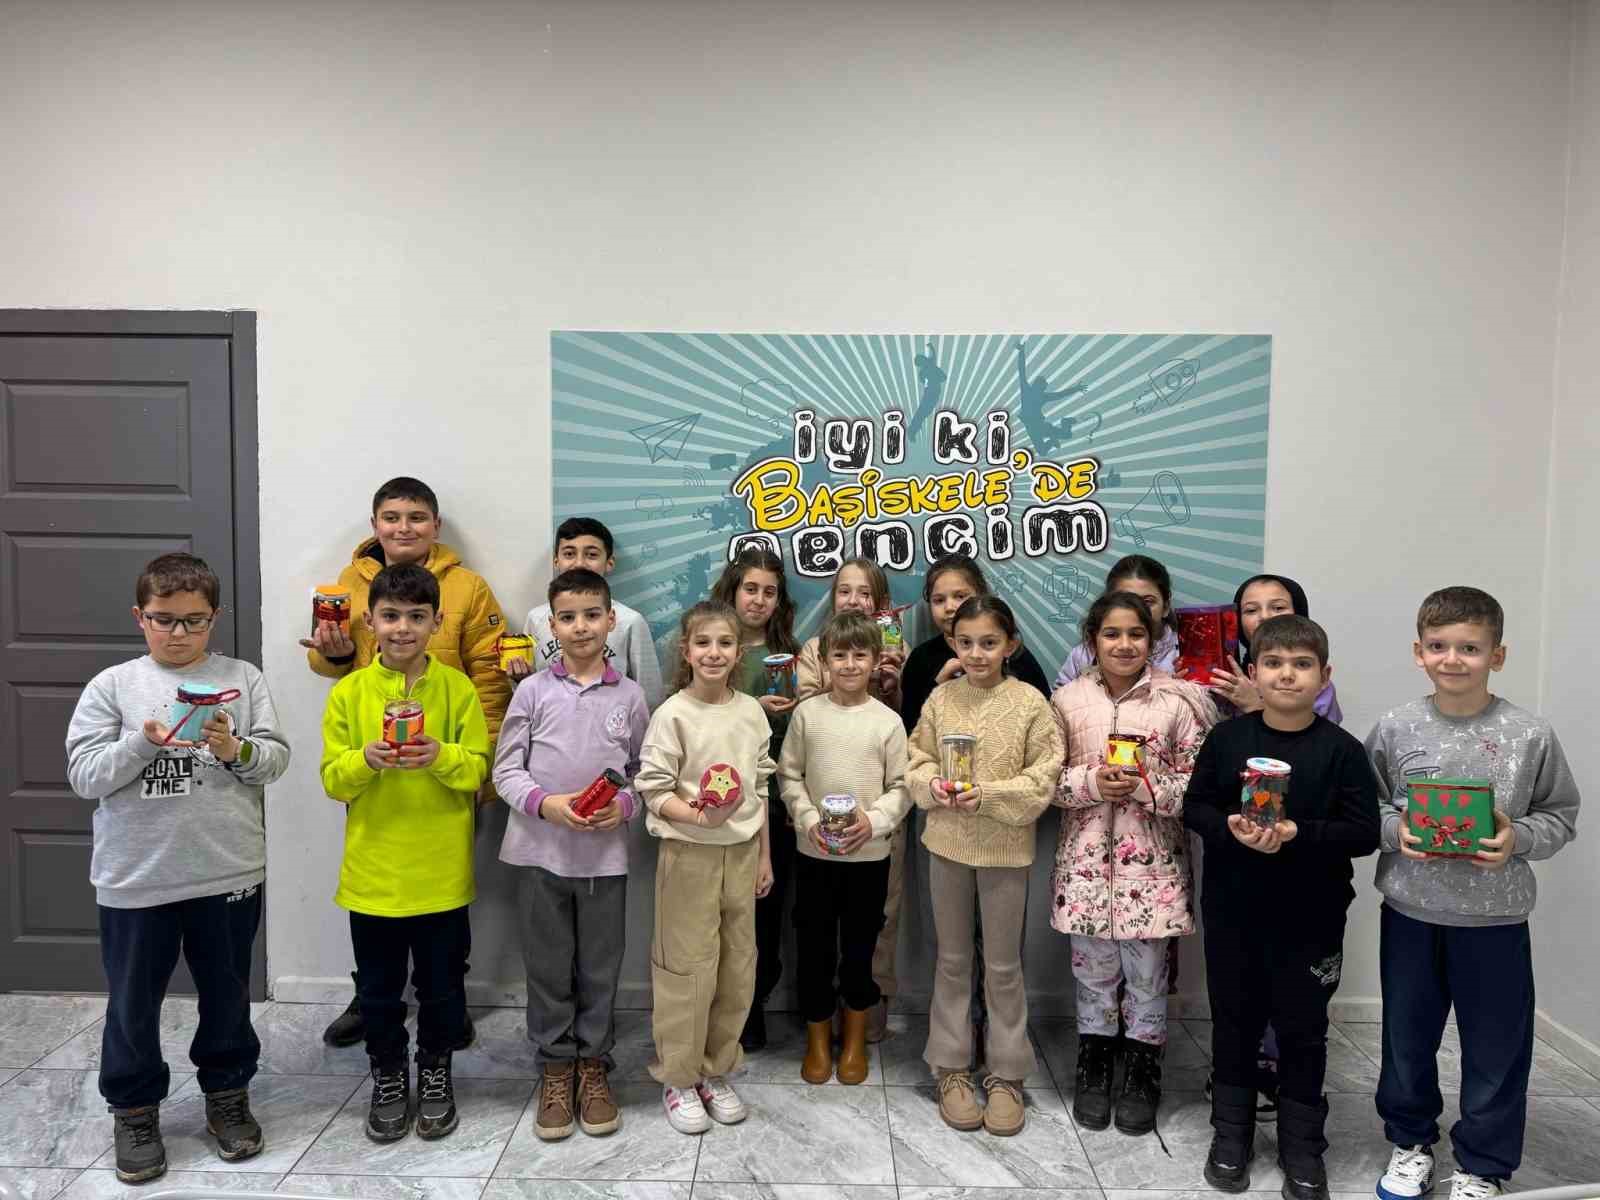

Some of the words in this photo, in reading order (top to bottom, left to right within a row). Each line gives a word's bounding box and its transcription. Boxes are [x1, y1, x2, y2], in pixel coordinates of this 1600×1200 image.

[795, 411, 904, 474] iyi
[935, 411, 1009, 464] ki
[143, 758, 191, 779] GOAL
[144, 778, 185, 796] TIME
